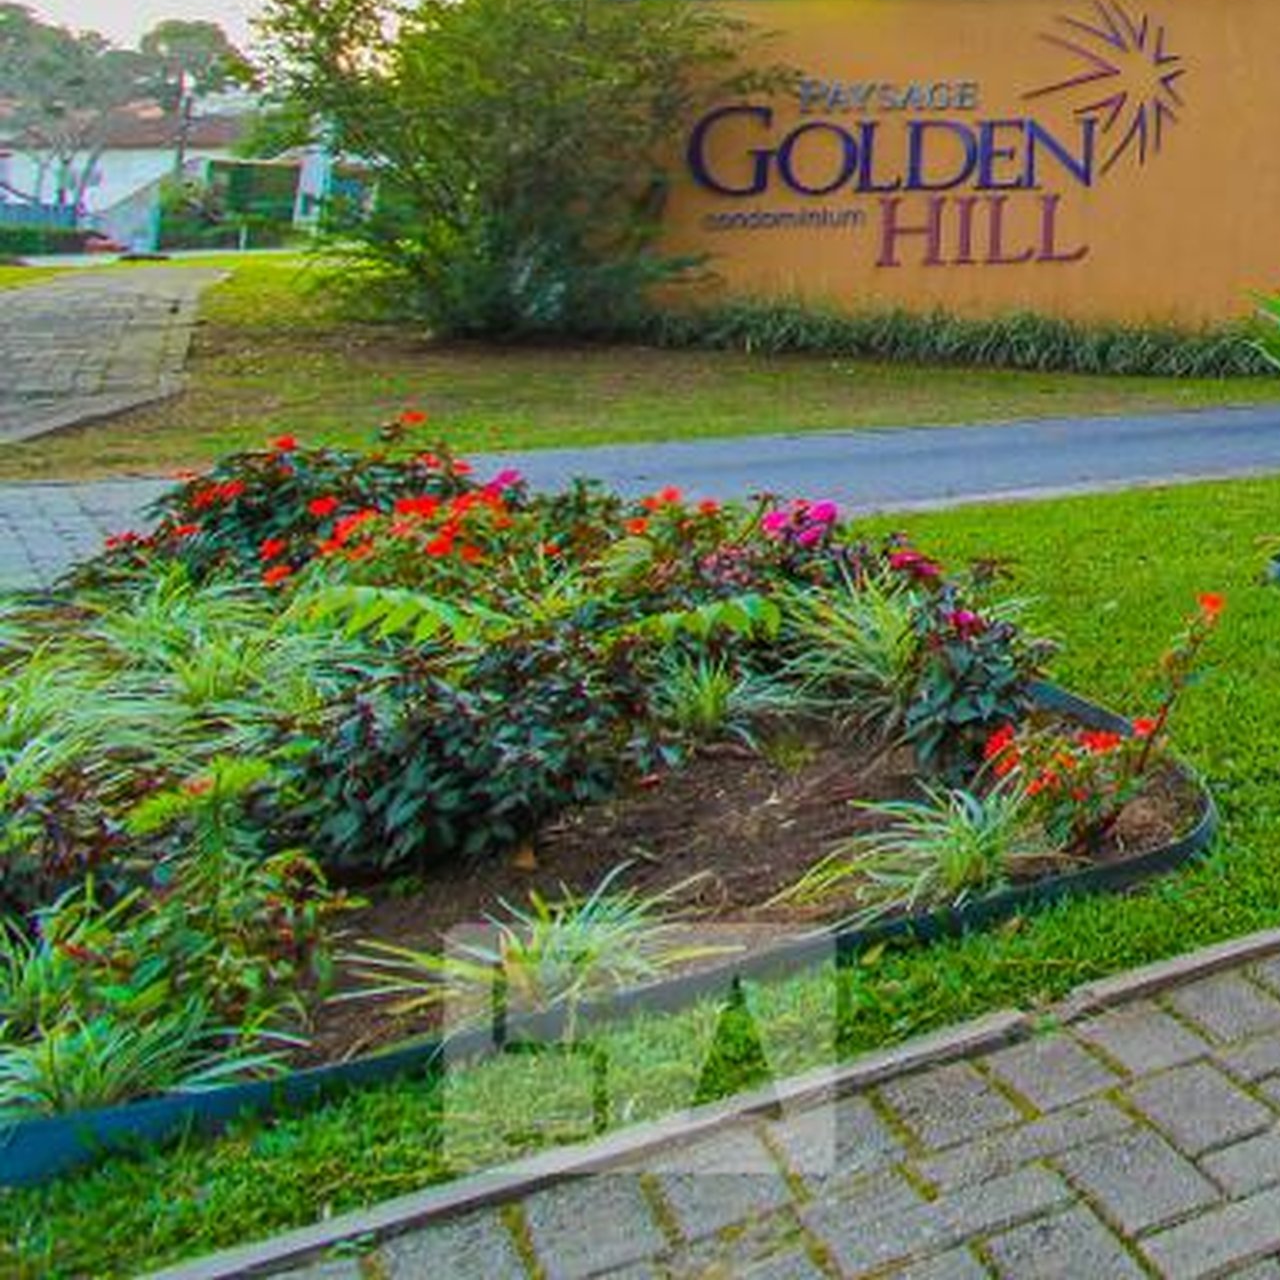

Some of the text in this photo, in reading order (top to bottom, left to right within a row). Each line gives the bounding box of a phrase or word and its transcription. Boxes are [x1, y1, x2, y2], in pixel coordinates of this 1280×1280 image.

[799, 78, 978, 112] PAYSAGE
[686, 105, 1099, 198] GOLDEN
[703, 206, 866, 232] condominium
[874, 193, 1090, 269] HILL
